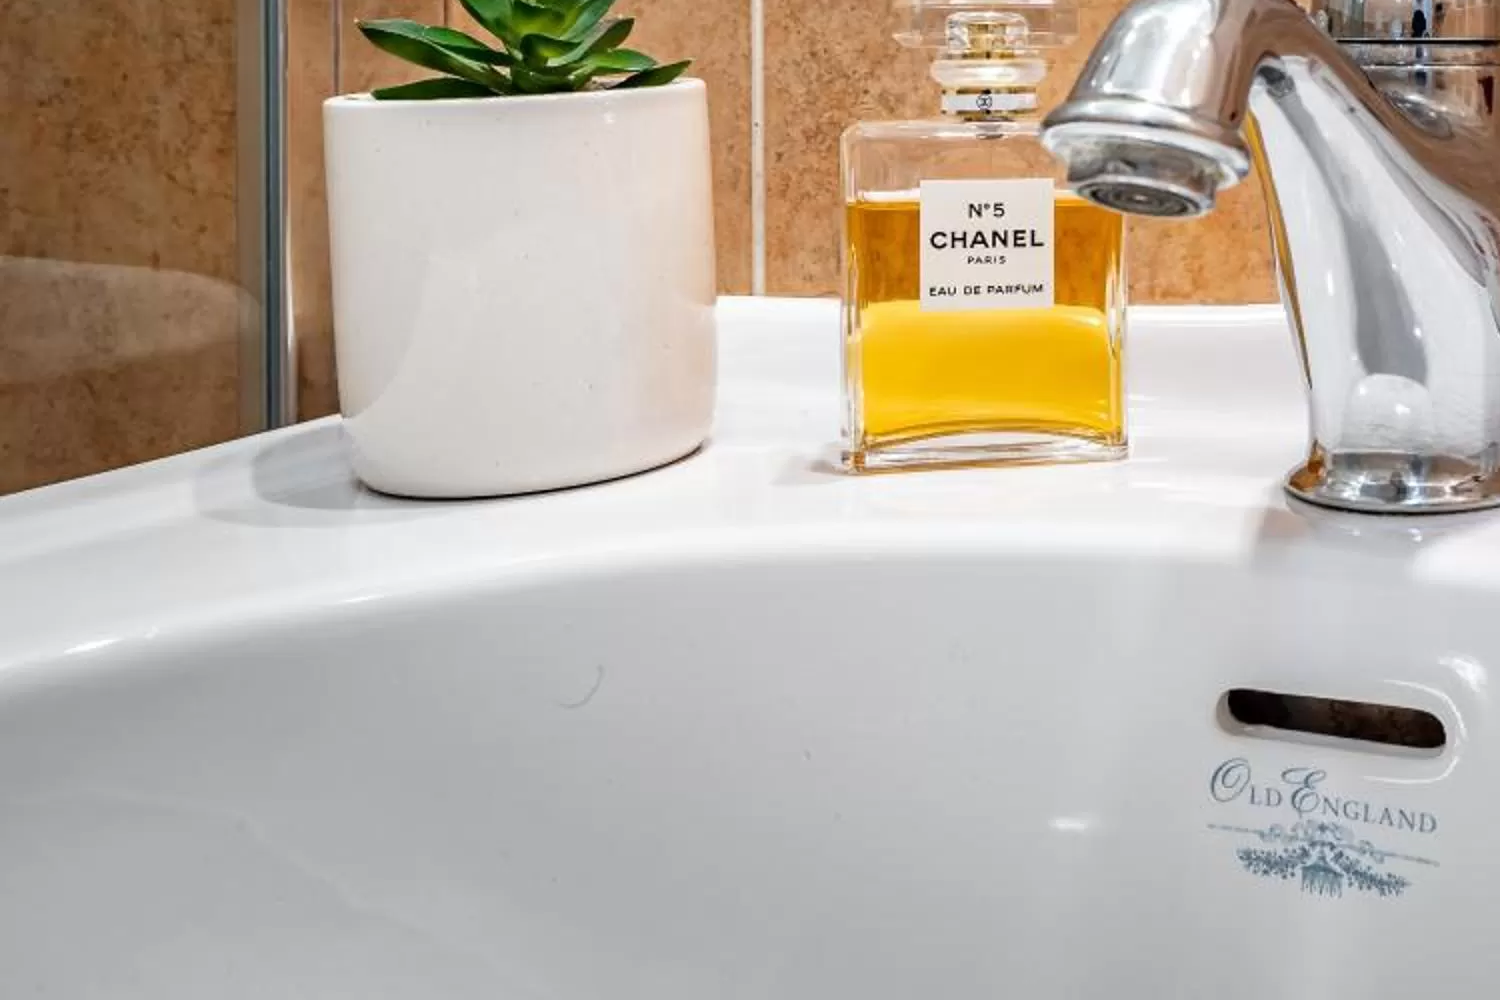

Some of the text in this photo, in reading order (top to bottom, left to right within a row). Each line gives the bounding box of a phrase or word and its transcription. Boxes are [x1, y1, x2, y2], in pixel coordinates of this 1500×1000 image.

[929, 229, 1044, 249] CHANEL
[967, 256, 1006, 265] PARIS
[929, 283, 1044, 297] EAU DE PARFUM
